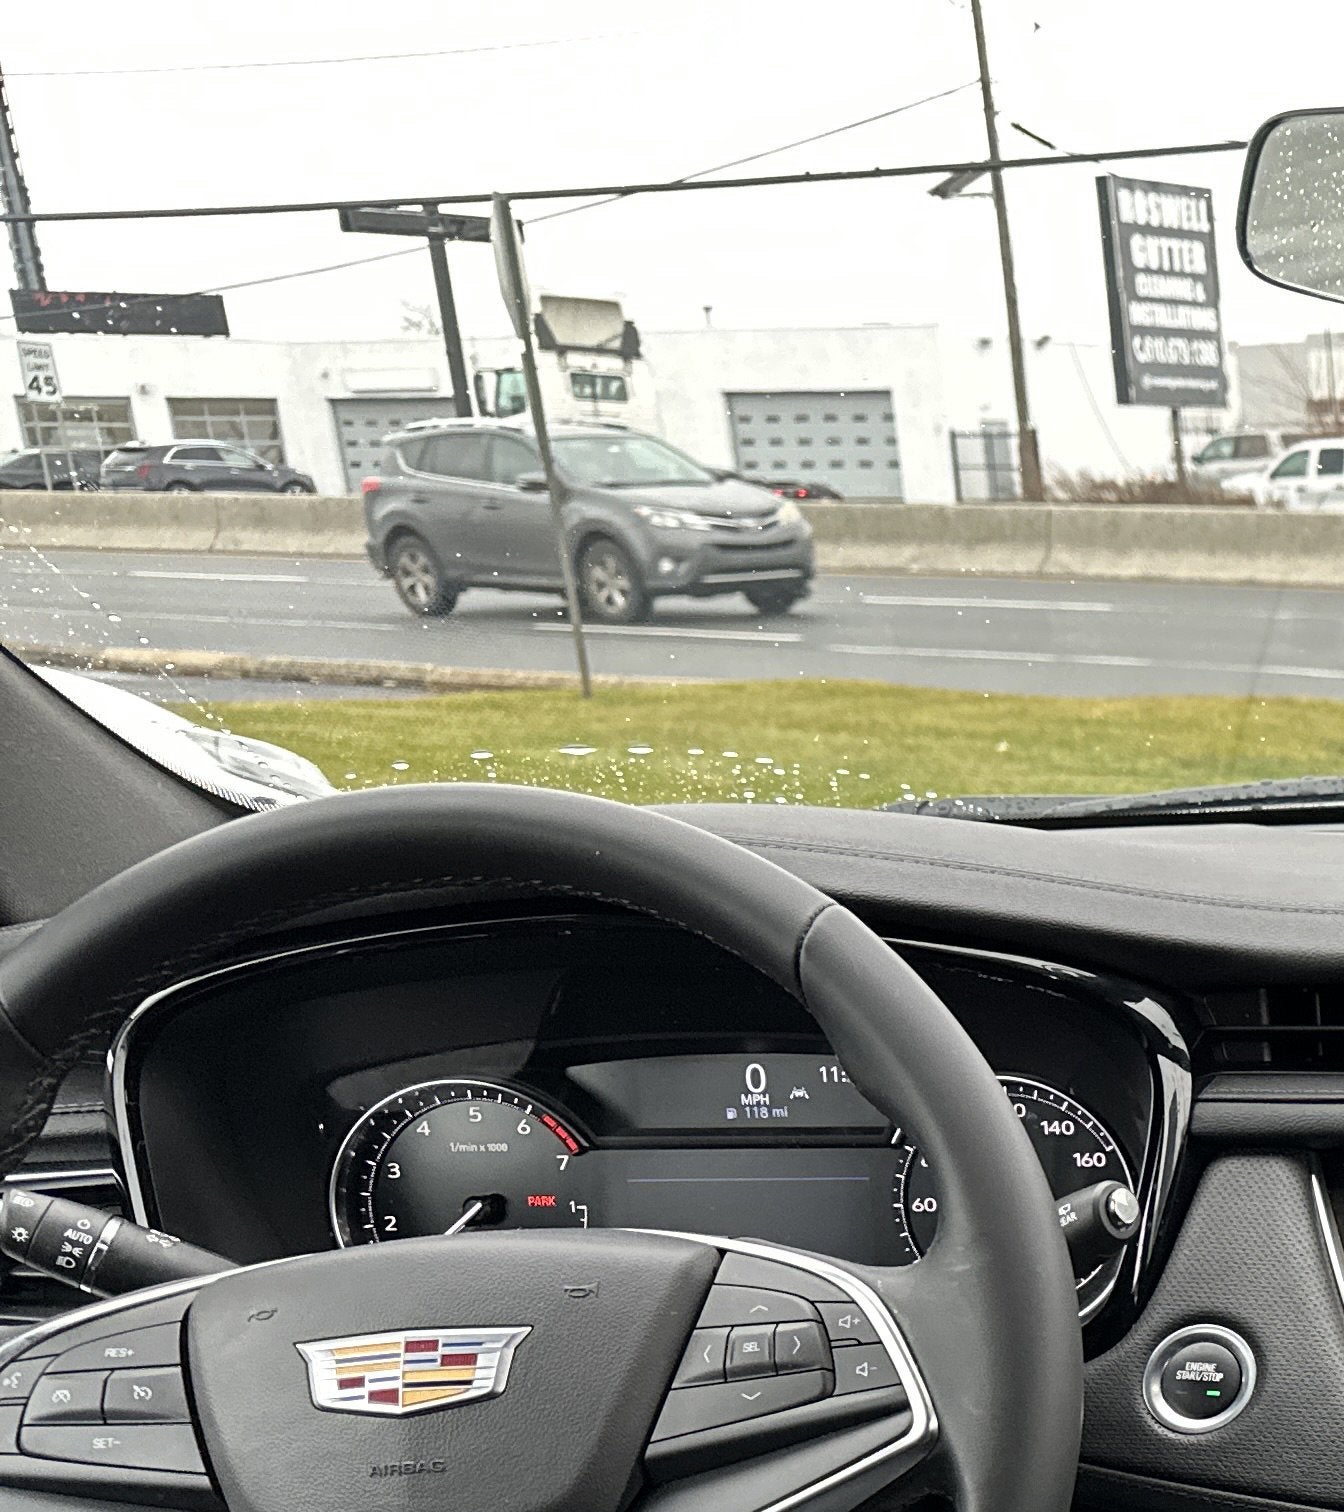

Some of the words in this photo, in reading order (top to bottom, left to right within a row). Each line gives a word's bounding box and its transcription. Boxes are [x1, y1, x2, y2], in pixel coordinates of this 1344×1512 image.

[1117, 188, 1211, 233] ROSWELL
[1130, 232, 1207, 275] GUTTER
[28, 374, 57, 396] 45
[745, 1063, 767, 1094] 0
[741, 1093, 770, 1106] MPH
[468, 1107, 482, 1123] 5
[745, 1106, 769, 1119] 118
[772, 1106, 789, 1118] mi
[415, 1120, 431, 1136] 4
[517, 1119, 531, 1135] 6
[1040, 1120, 1075, 1135] 140
[450, 1141, 476, 1153] 1/min
[486, 1141, 508, 1153] 1000
[556, 1155, 570, 1171] 7
[1072, 1152, 1107, 1168] 160
[387, 1162, 401, 1179] 3
[527, 1195, 556, 1207] PARK
[569, 1201, 577, 1213] 1
[911, 1197, 937, 1213] 60
[384, 1216, 399, 1232] 2
[63, 1228, 93, 1245] AUTO
[742, 1341, 761, 1353] SEL
[1185, 1361, 1217, 1373] ENGINE
[1175, 1370, 1224, 1382] START/STOP
[369, 1460, 448, 1478] AIRBAG
